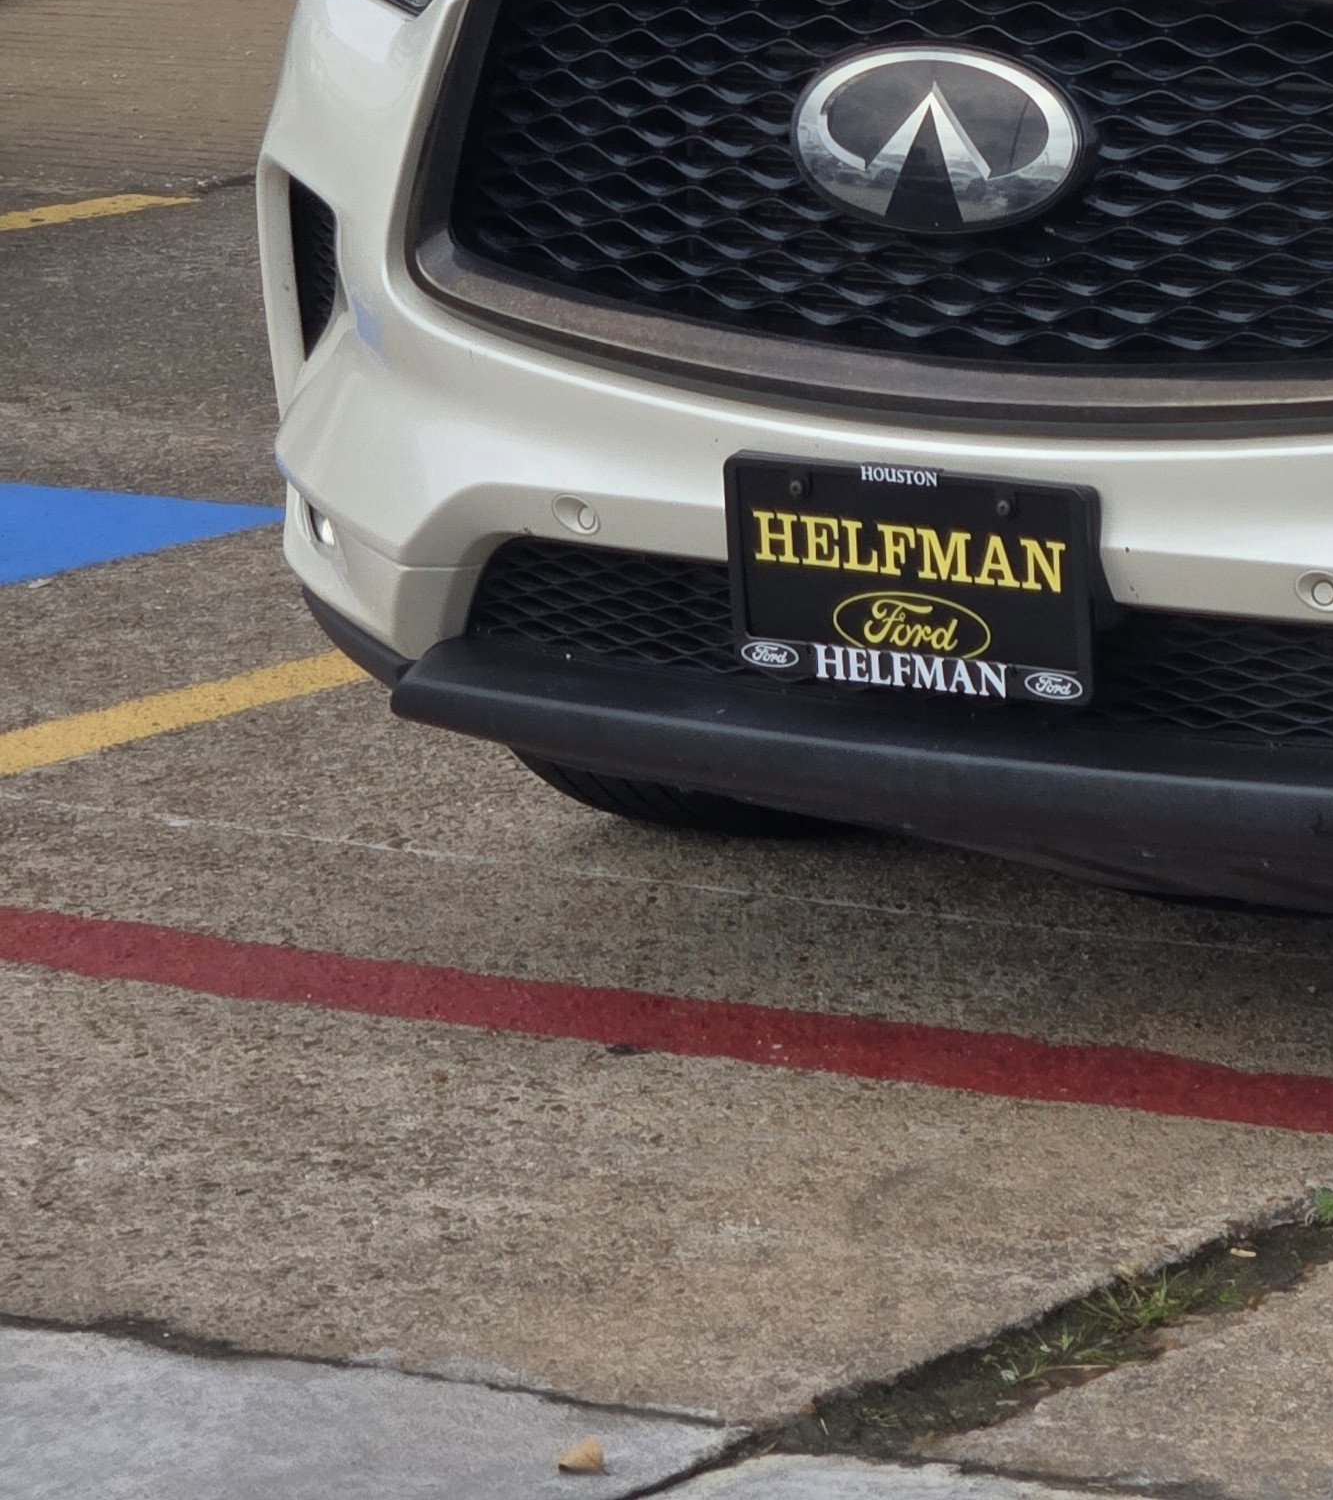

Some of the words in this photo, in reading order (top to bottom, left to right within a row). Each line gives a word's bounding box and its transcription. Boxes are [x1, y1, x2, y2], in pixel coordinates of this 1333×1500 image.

[860, 465, 938, 487] HOUSTON
[752, 510, 1066, 594] HELFMAN
[863, 598, 959, 652] Ford
[750, 645, 788, 666] Ford
[815, 643, 1008, 699] HELFMAN
[1035, 675, 1073, 697] Ford
